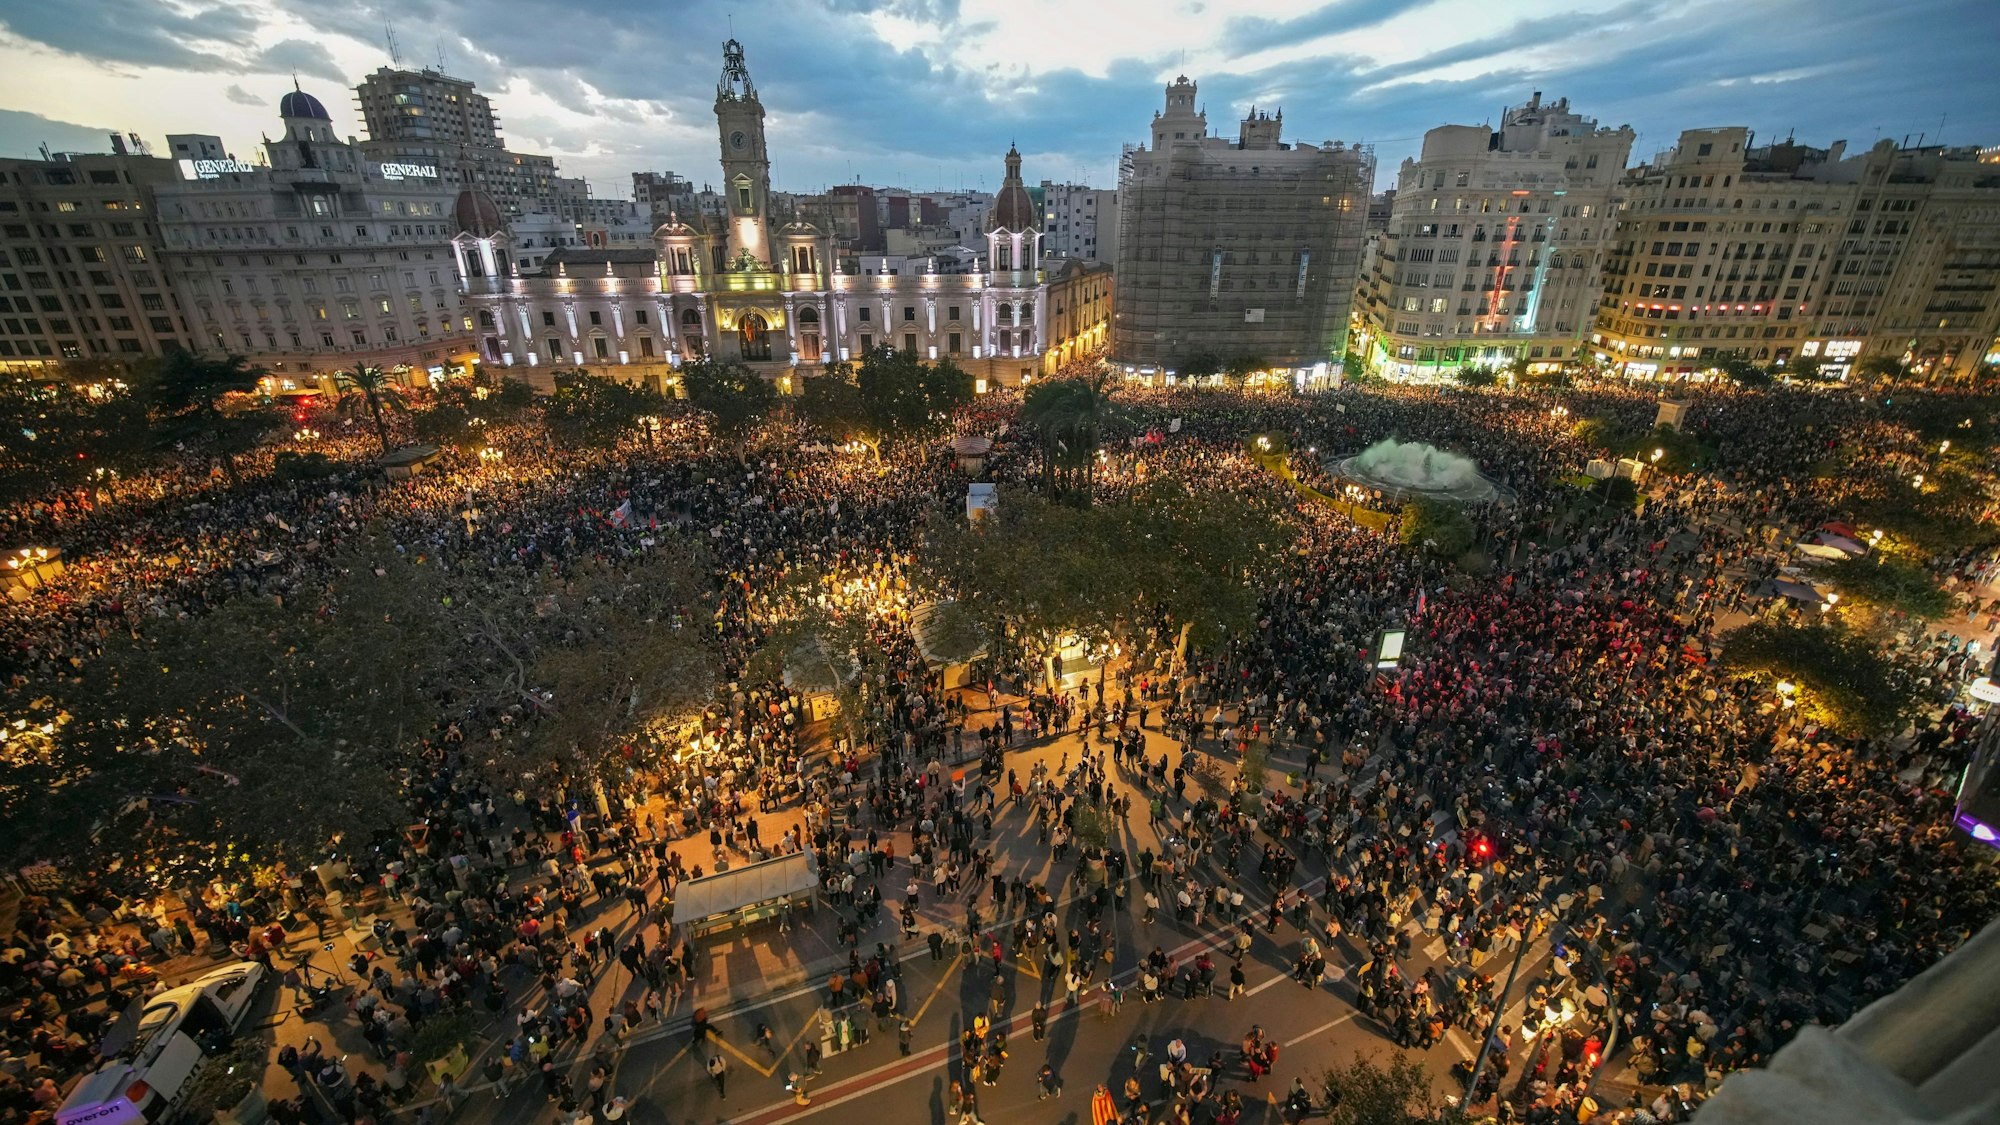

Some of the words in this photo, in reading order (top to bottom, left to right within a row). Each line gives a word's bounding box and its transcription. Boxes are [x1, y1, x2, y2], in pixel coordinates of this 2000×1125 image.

[194, 159, 254, 172] GENERALI
[381, 163, 437, 178] GENERALI
[66, 1105, 120, 1125] overon
